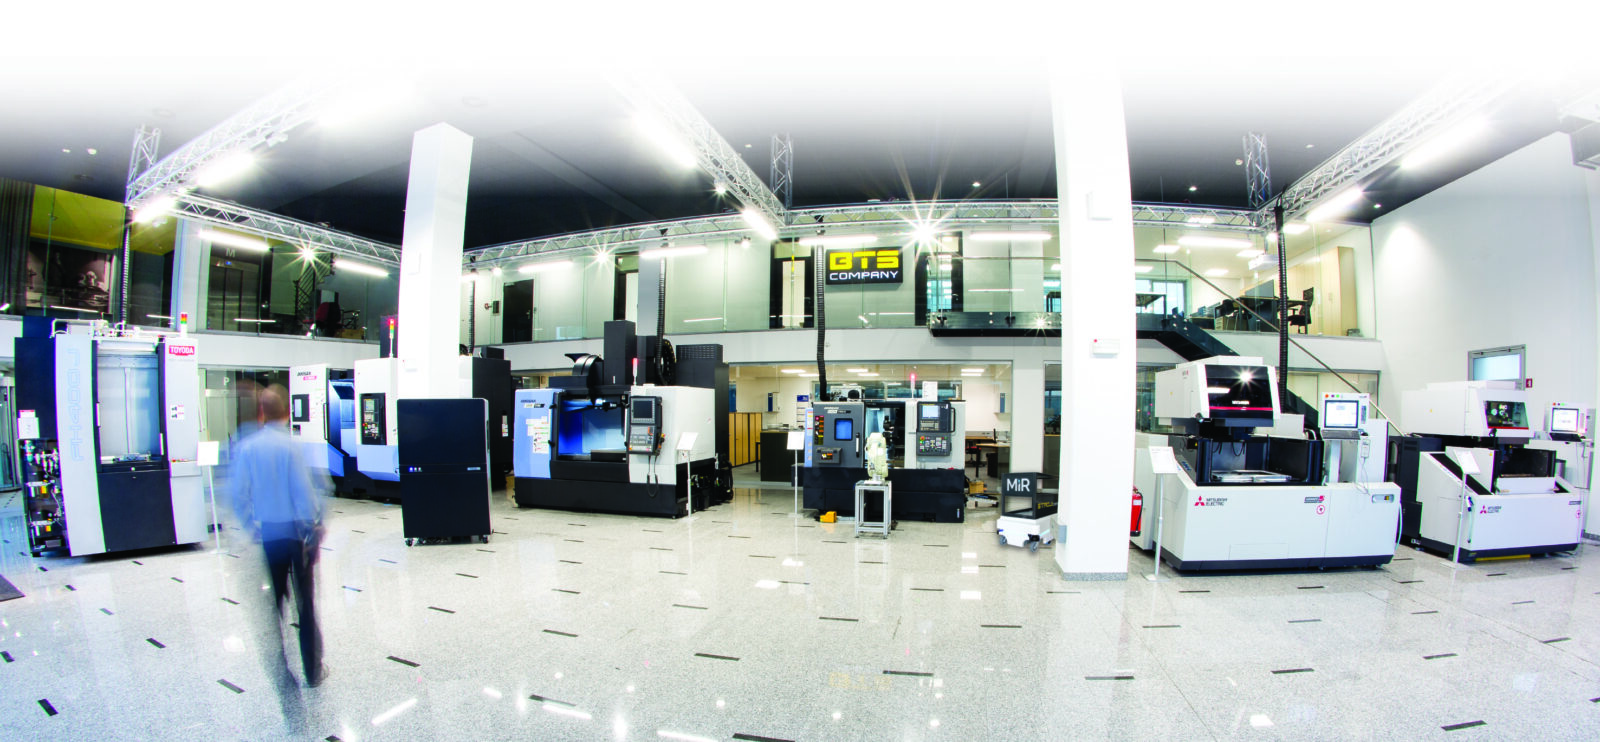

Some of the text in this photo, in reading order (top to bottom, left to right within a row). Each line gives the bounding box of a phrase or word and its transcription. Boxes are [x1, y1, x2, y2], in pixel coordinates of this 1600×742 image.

[226, 248, 235, 257] M
[829, 250, 899, 270] BTS
[829, 270, 898, 281] COMPANY
[170, 346, 194, 354] TOYODA
[223, 376, 230, 386] P
[68, 348, 84, 461] FH400J
[1006, 477, 1030, 492] MiR
